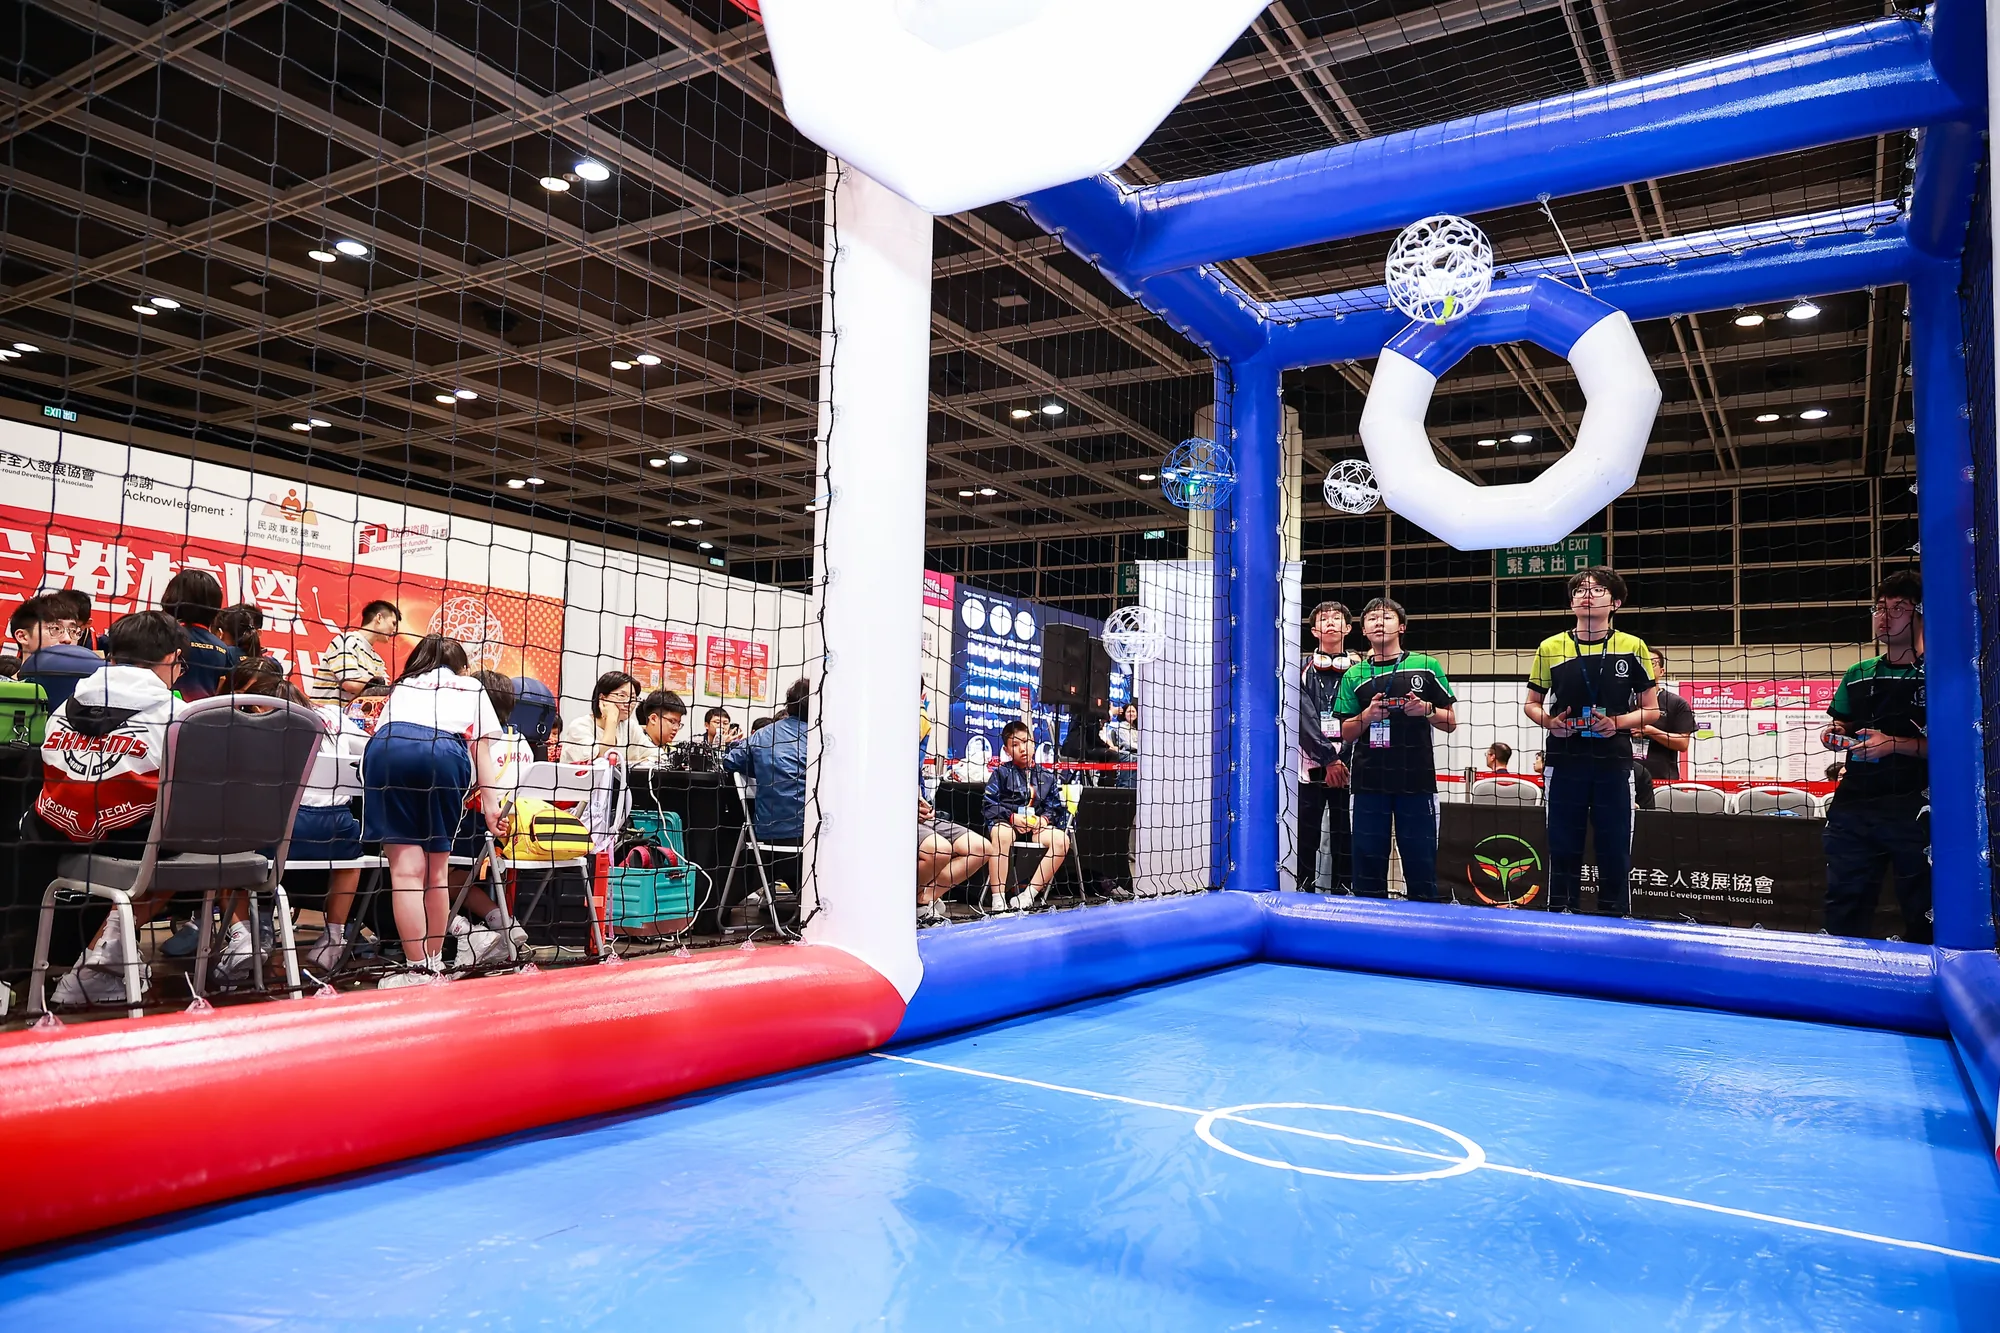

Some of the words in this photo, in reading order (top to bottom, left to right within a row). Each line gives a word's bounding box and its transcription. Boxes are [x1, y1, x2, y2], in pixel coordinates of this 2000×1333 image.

[21, 471, 60, 483] Development
[61, 479, 94, 489] Association
[243, 529, 265, 541] Home
[266, 532, 290, 545] Affairs
[290, 537, 332, 551] Department
[1567, 538, 1590, 551] EXIT
[190, 641, 214, 650] SOCCER
